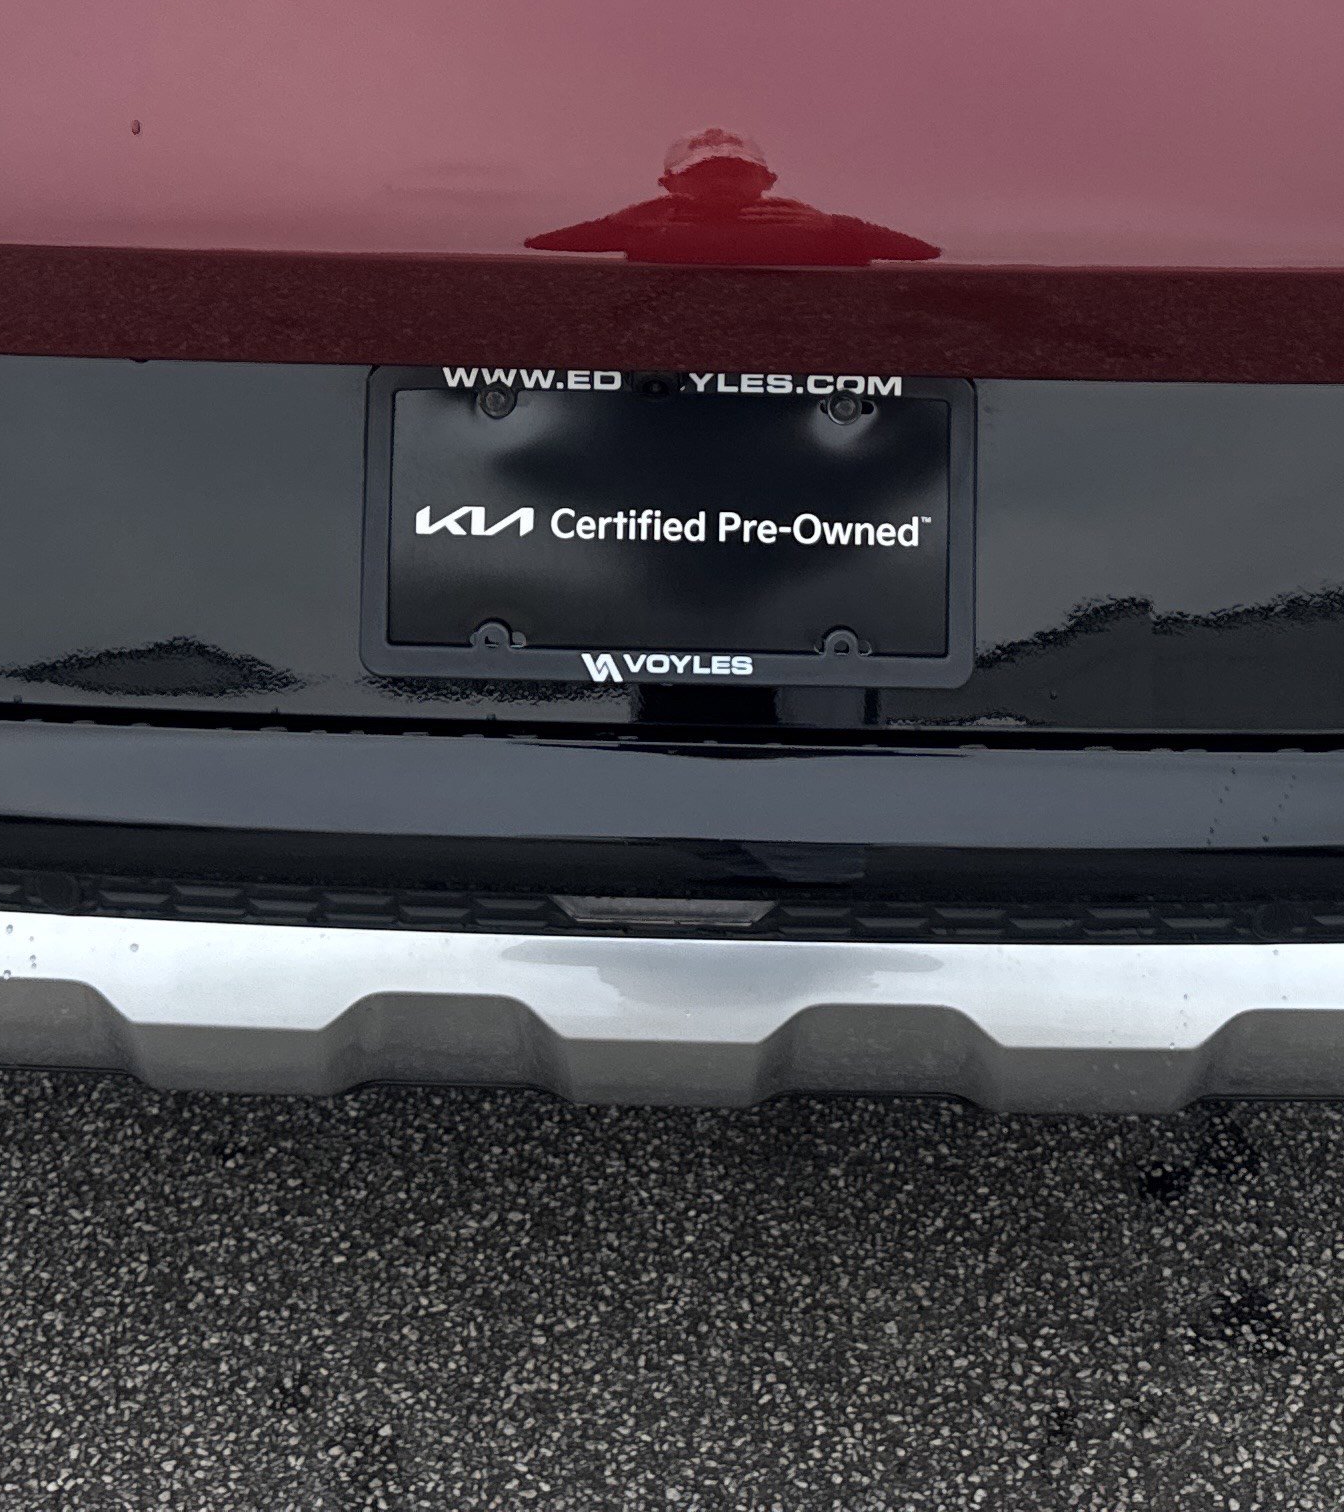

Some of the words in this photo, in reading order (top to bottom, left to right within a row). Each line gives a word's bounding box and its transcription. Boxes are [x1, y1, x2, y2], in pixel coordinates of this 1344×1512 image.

[442, 366, 902, 397] WWW.EDYLES.COM
[415, 505, 535, 537] KIA
[550, 507, 706, 542] Certified
[623, 653, 754, 675] VOYLES
